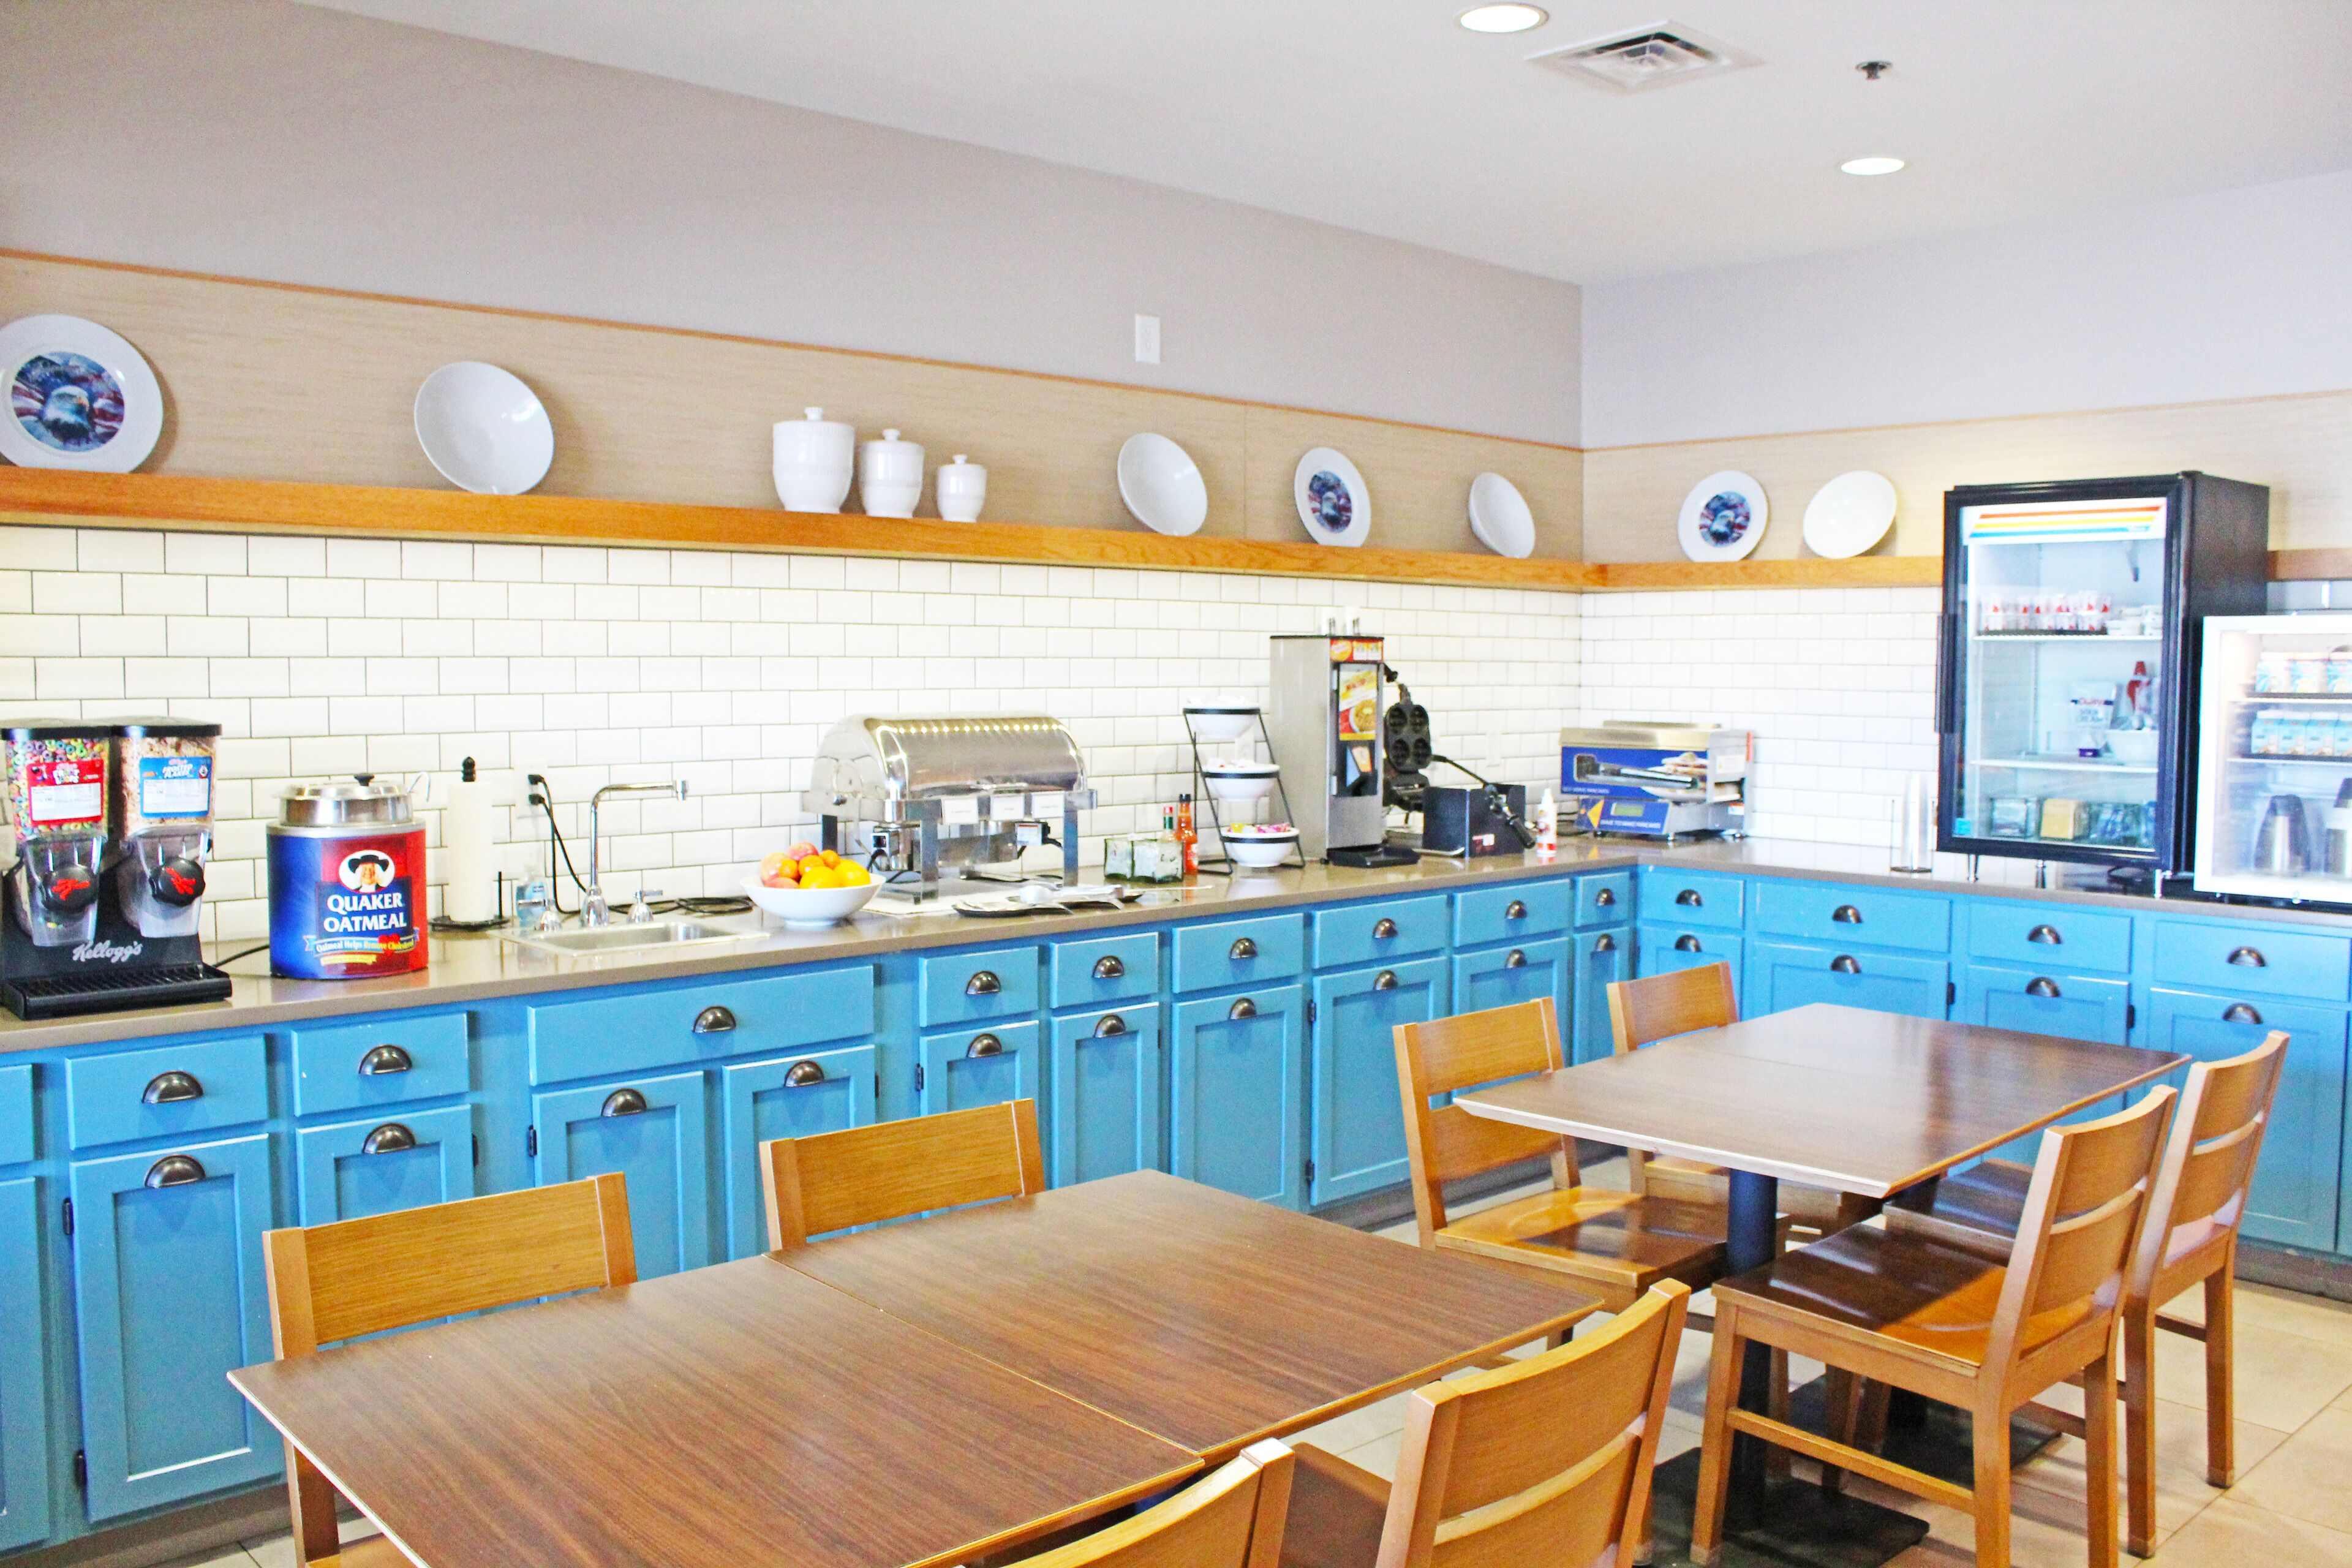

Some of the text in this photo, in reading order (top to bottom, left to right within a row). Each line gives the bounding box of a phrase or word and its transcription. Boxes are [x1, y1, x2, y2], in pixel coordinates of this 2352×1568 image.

[327, 892, 402, 915] QUAKER
[323, 912, 407, 932] OATMEAL
[72, 940, 143, 963] Kellogg's
[316, 940, 344, 953] Oatmeal
[344, 940, 363, 949] Helps
